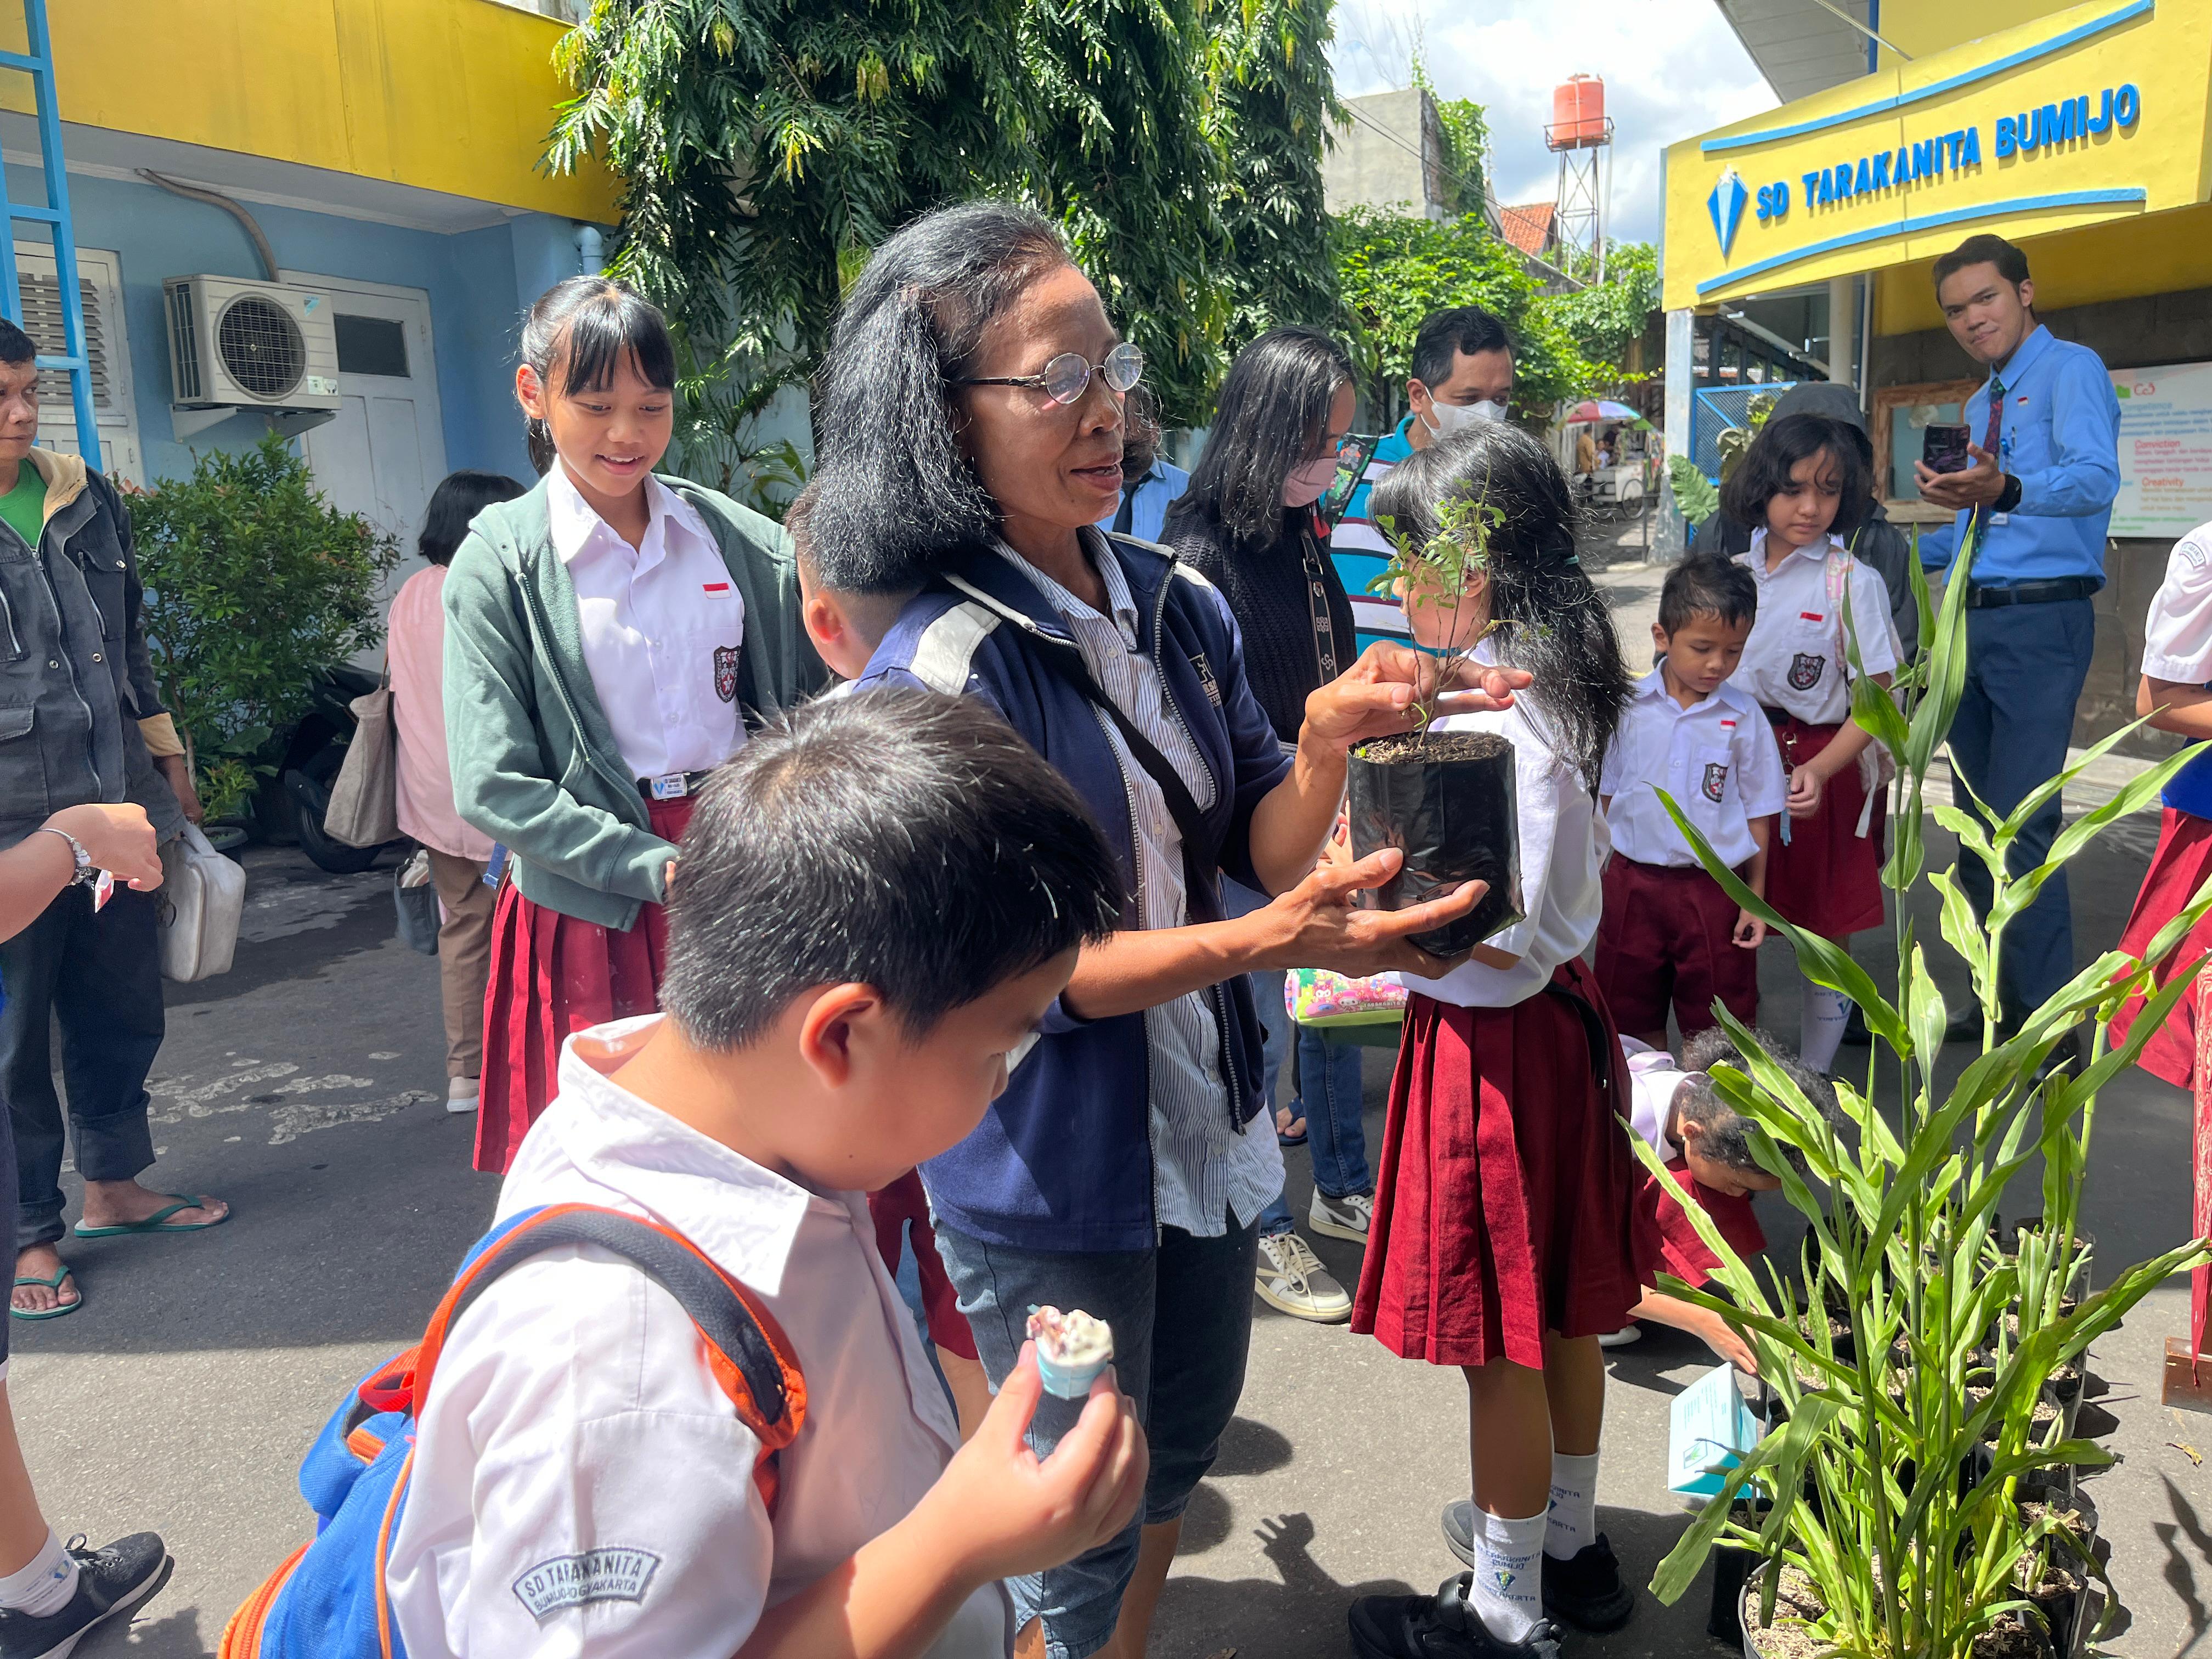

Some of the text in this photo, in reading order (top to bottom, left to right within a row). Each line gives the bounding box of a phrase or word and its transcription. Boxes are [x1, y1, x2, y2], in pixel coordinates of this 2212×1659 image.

[1756, 84, 2139, 219] SD TARAKANITA BUMIJO
[2135, 439, 2181, 449] Conviction
[2141, 477, 2185, 488] Creativity
[525, 1575, 545, 1598] SD
